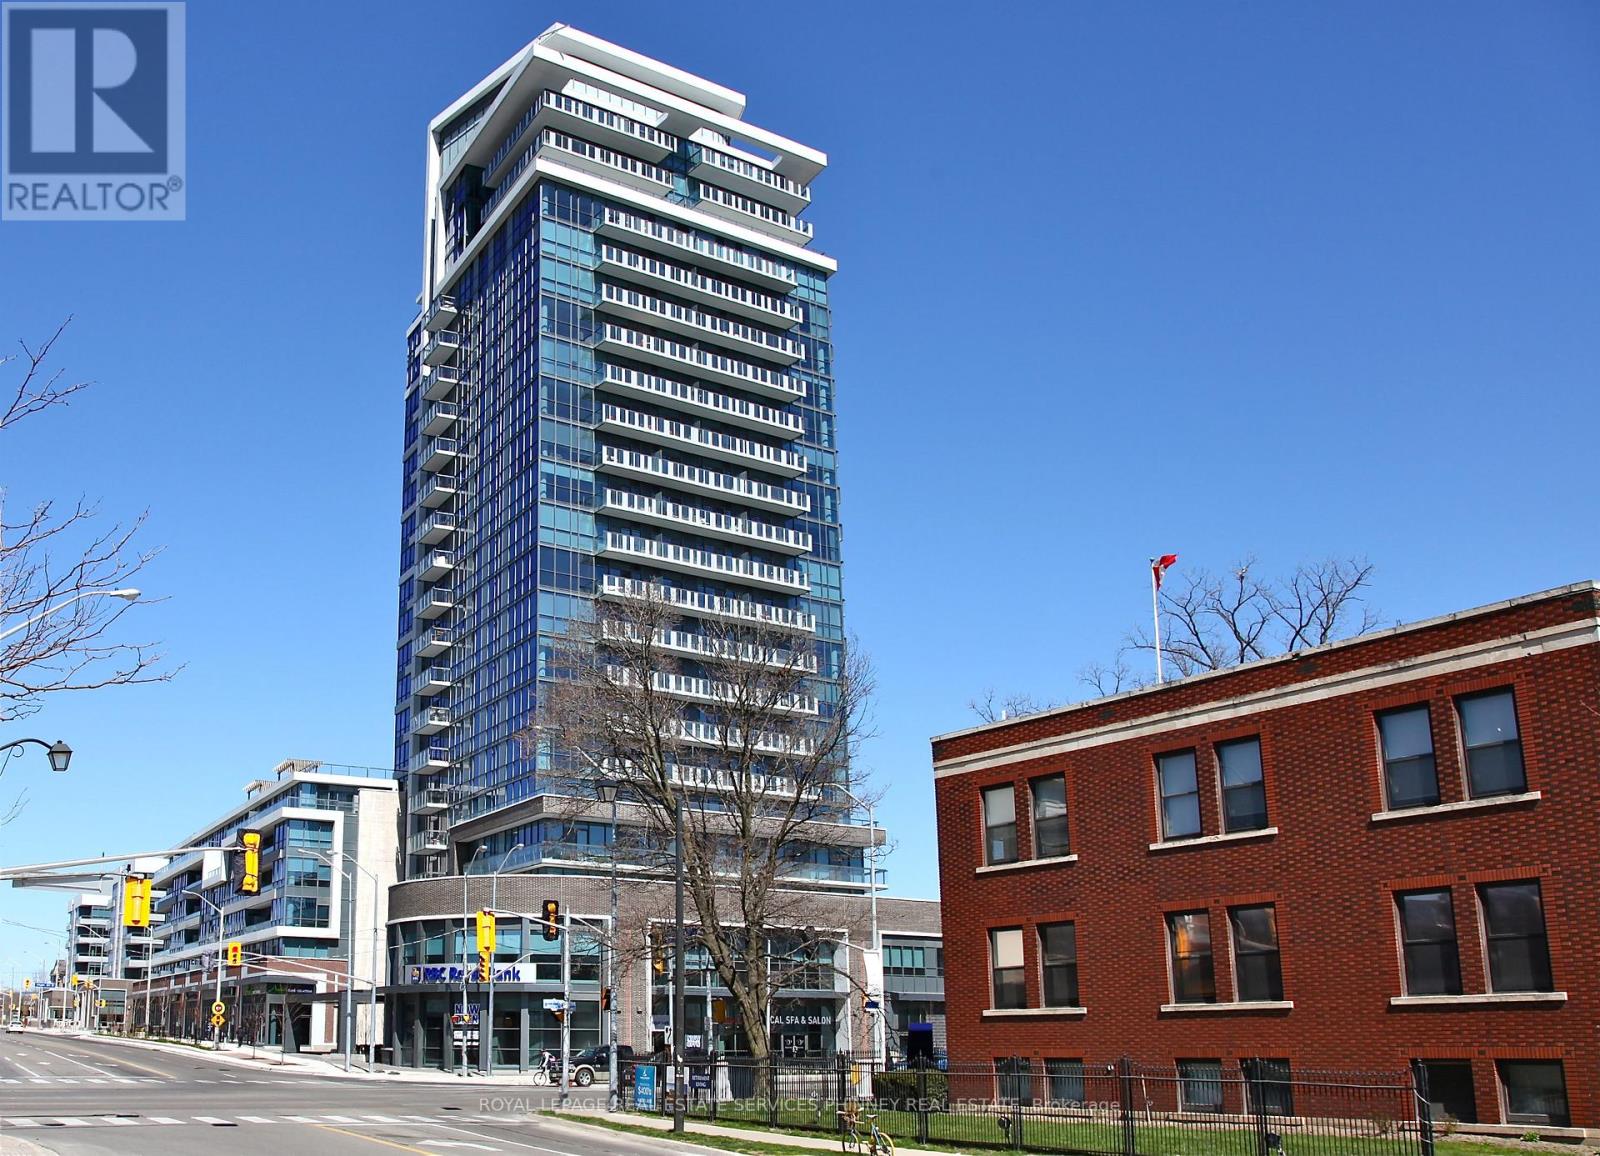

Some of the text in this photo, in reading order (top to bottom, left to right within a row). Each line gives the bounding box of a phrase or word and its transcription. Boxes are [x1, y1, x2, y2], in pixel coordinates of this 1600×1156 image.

[785, 1015, 799, 1025] SPA
[800, 1015, 806, 1025] &
[807, 1015, 831, 1025] SALON
